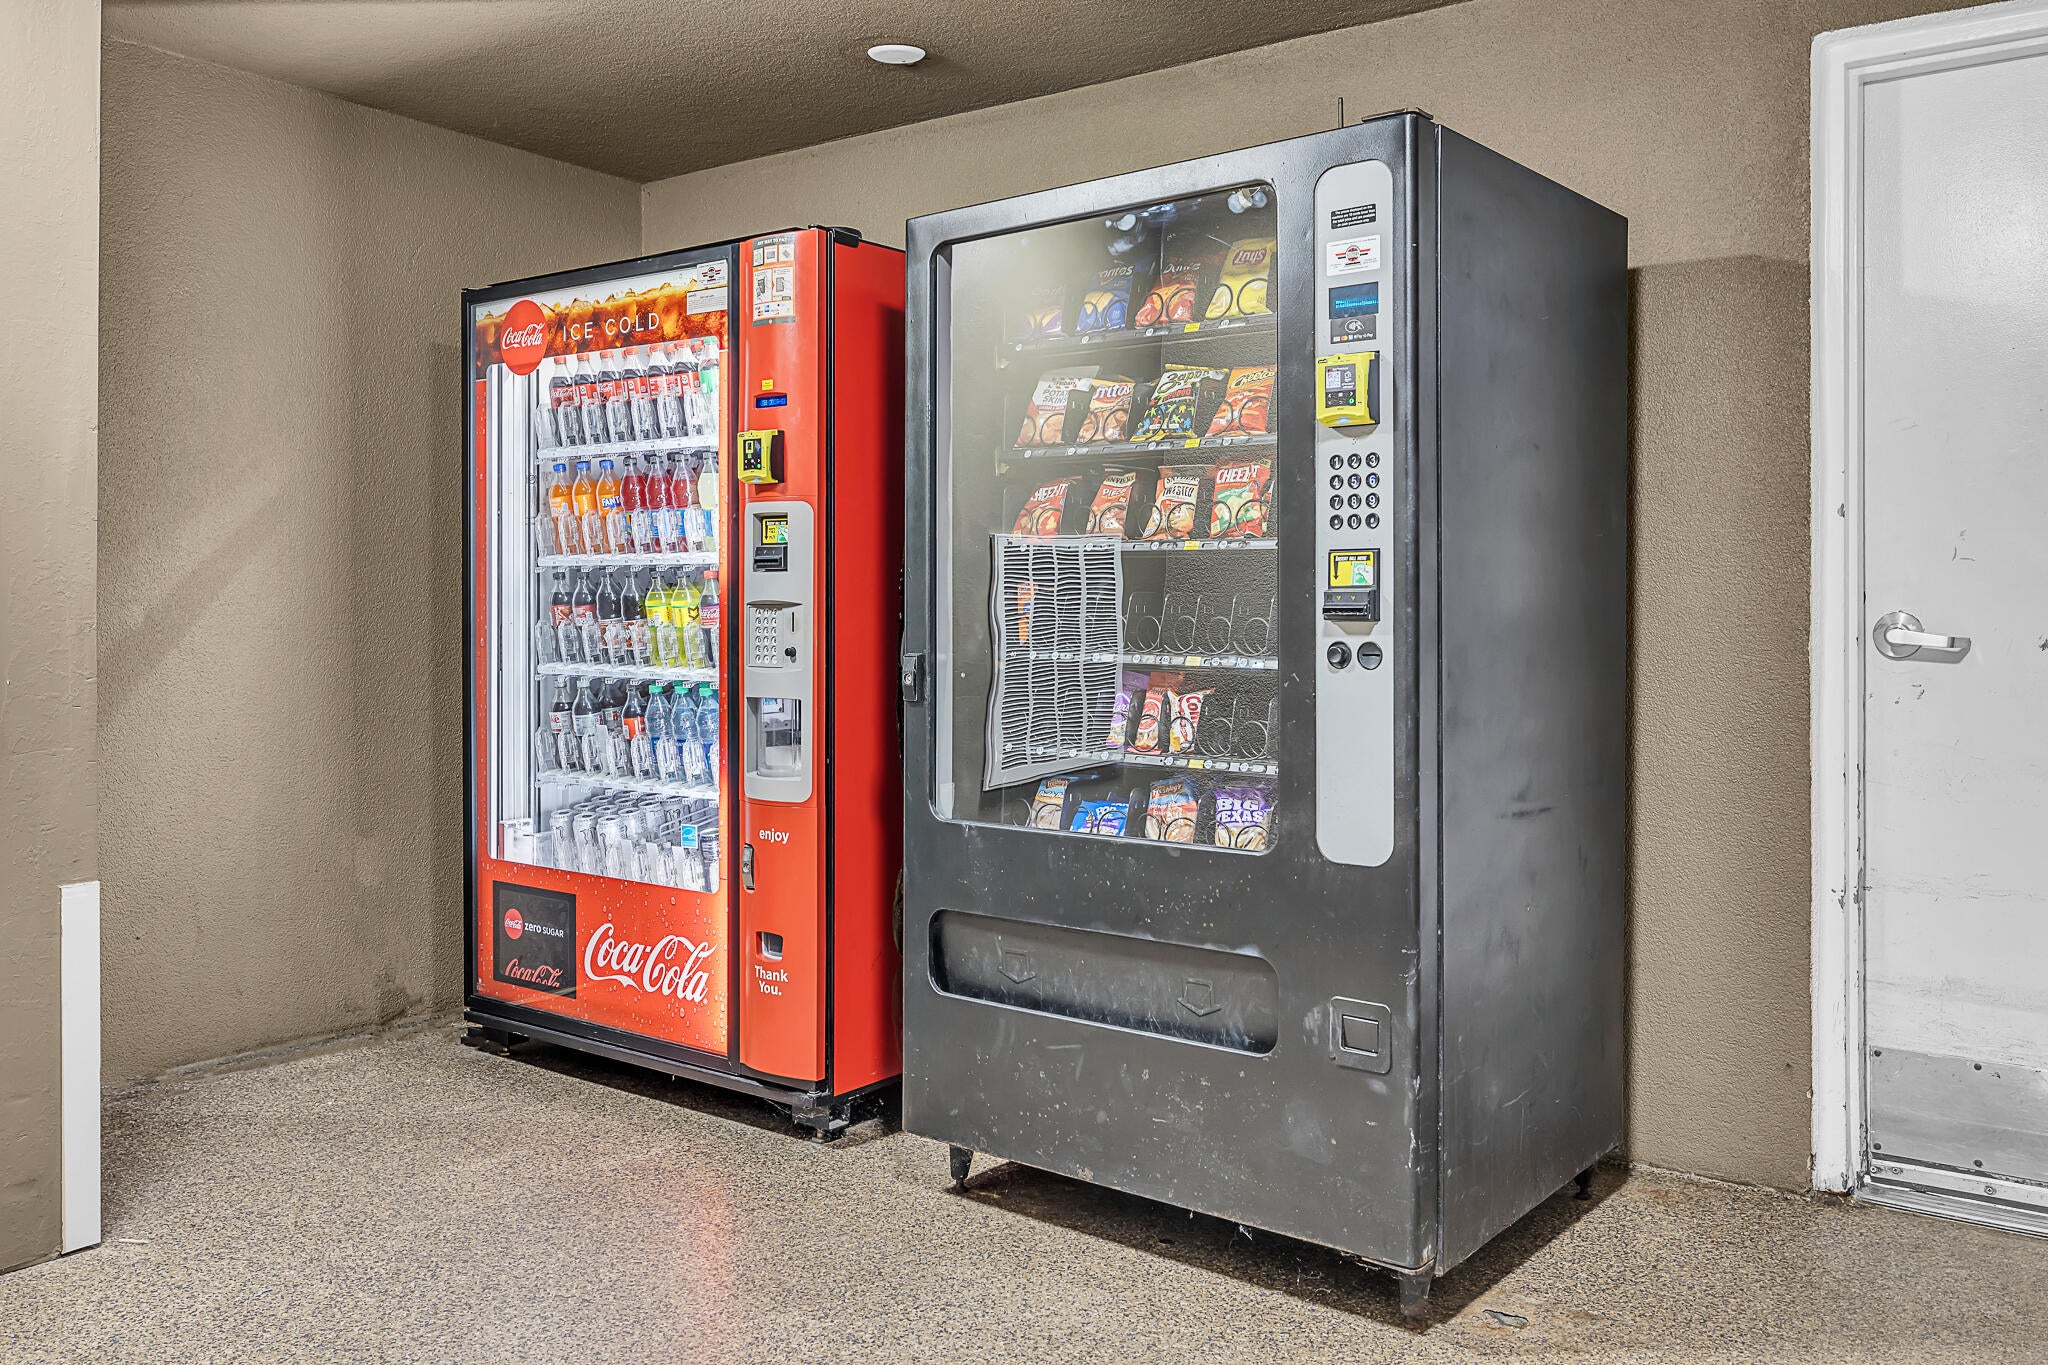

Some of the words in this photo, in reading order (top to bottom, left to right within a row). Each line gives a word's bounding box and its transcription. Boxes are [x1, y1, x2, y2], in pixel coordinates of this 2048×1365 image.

[562, 322, 594, 342] ICE
[605, 312, 660, 336] COLD
[502, 322, 542, 350] Coca-Cola
[1352, 456, 1357, 466] 2
[1369, 455, 1376, 465] 3
[1333, 477, 1339, 487] 4
[1351, 476, 1357, 486] 5
[1370, 475, 1376, 485] 6
[602, 496, 620, 508] FANT
[1333, 497, 1339, 507] 7
[1351, 496, 1357, 506] 8
[1369, 495, 1375, 505] 9
[1352, 516, 1357, 526] 0
[1217, 798, 1260, 811] BIG
[759, 828, 790, 844] enjoy
[524, 923, 542, 933] zero
[542, 927, 564, 937] SUGAR
[584, 922, 717, 1003] Coca-Cola
[754, 965, 788, 982] Thank
[758, 980, 782, 996] You.
